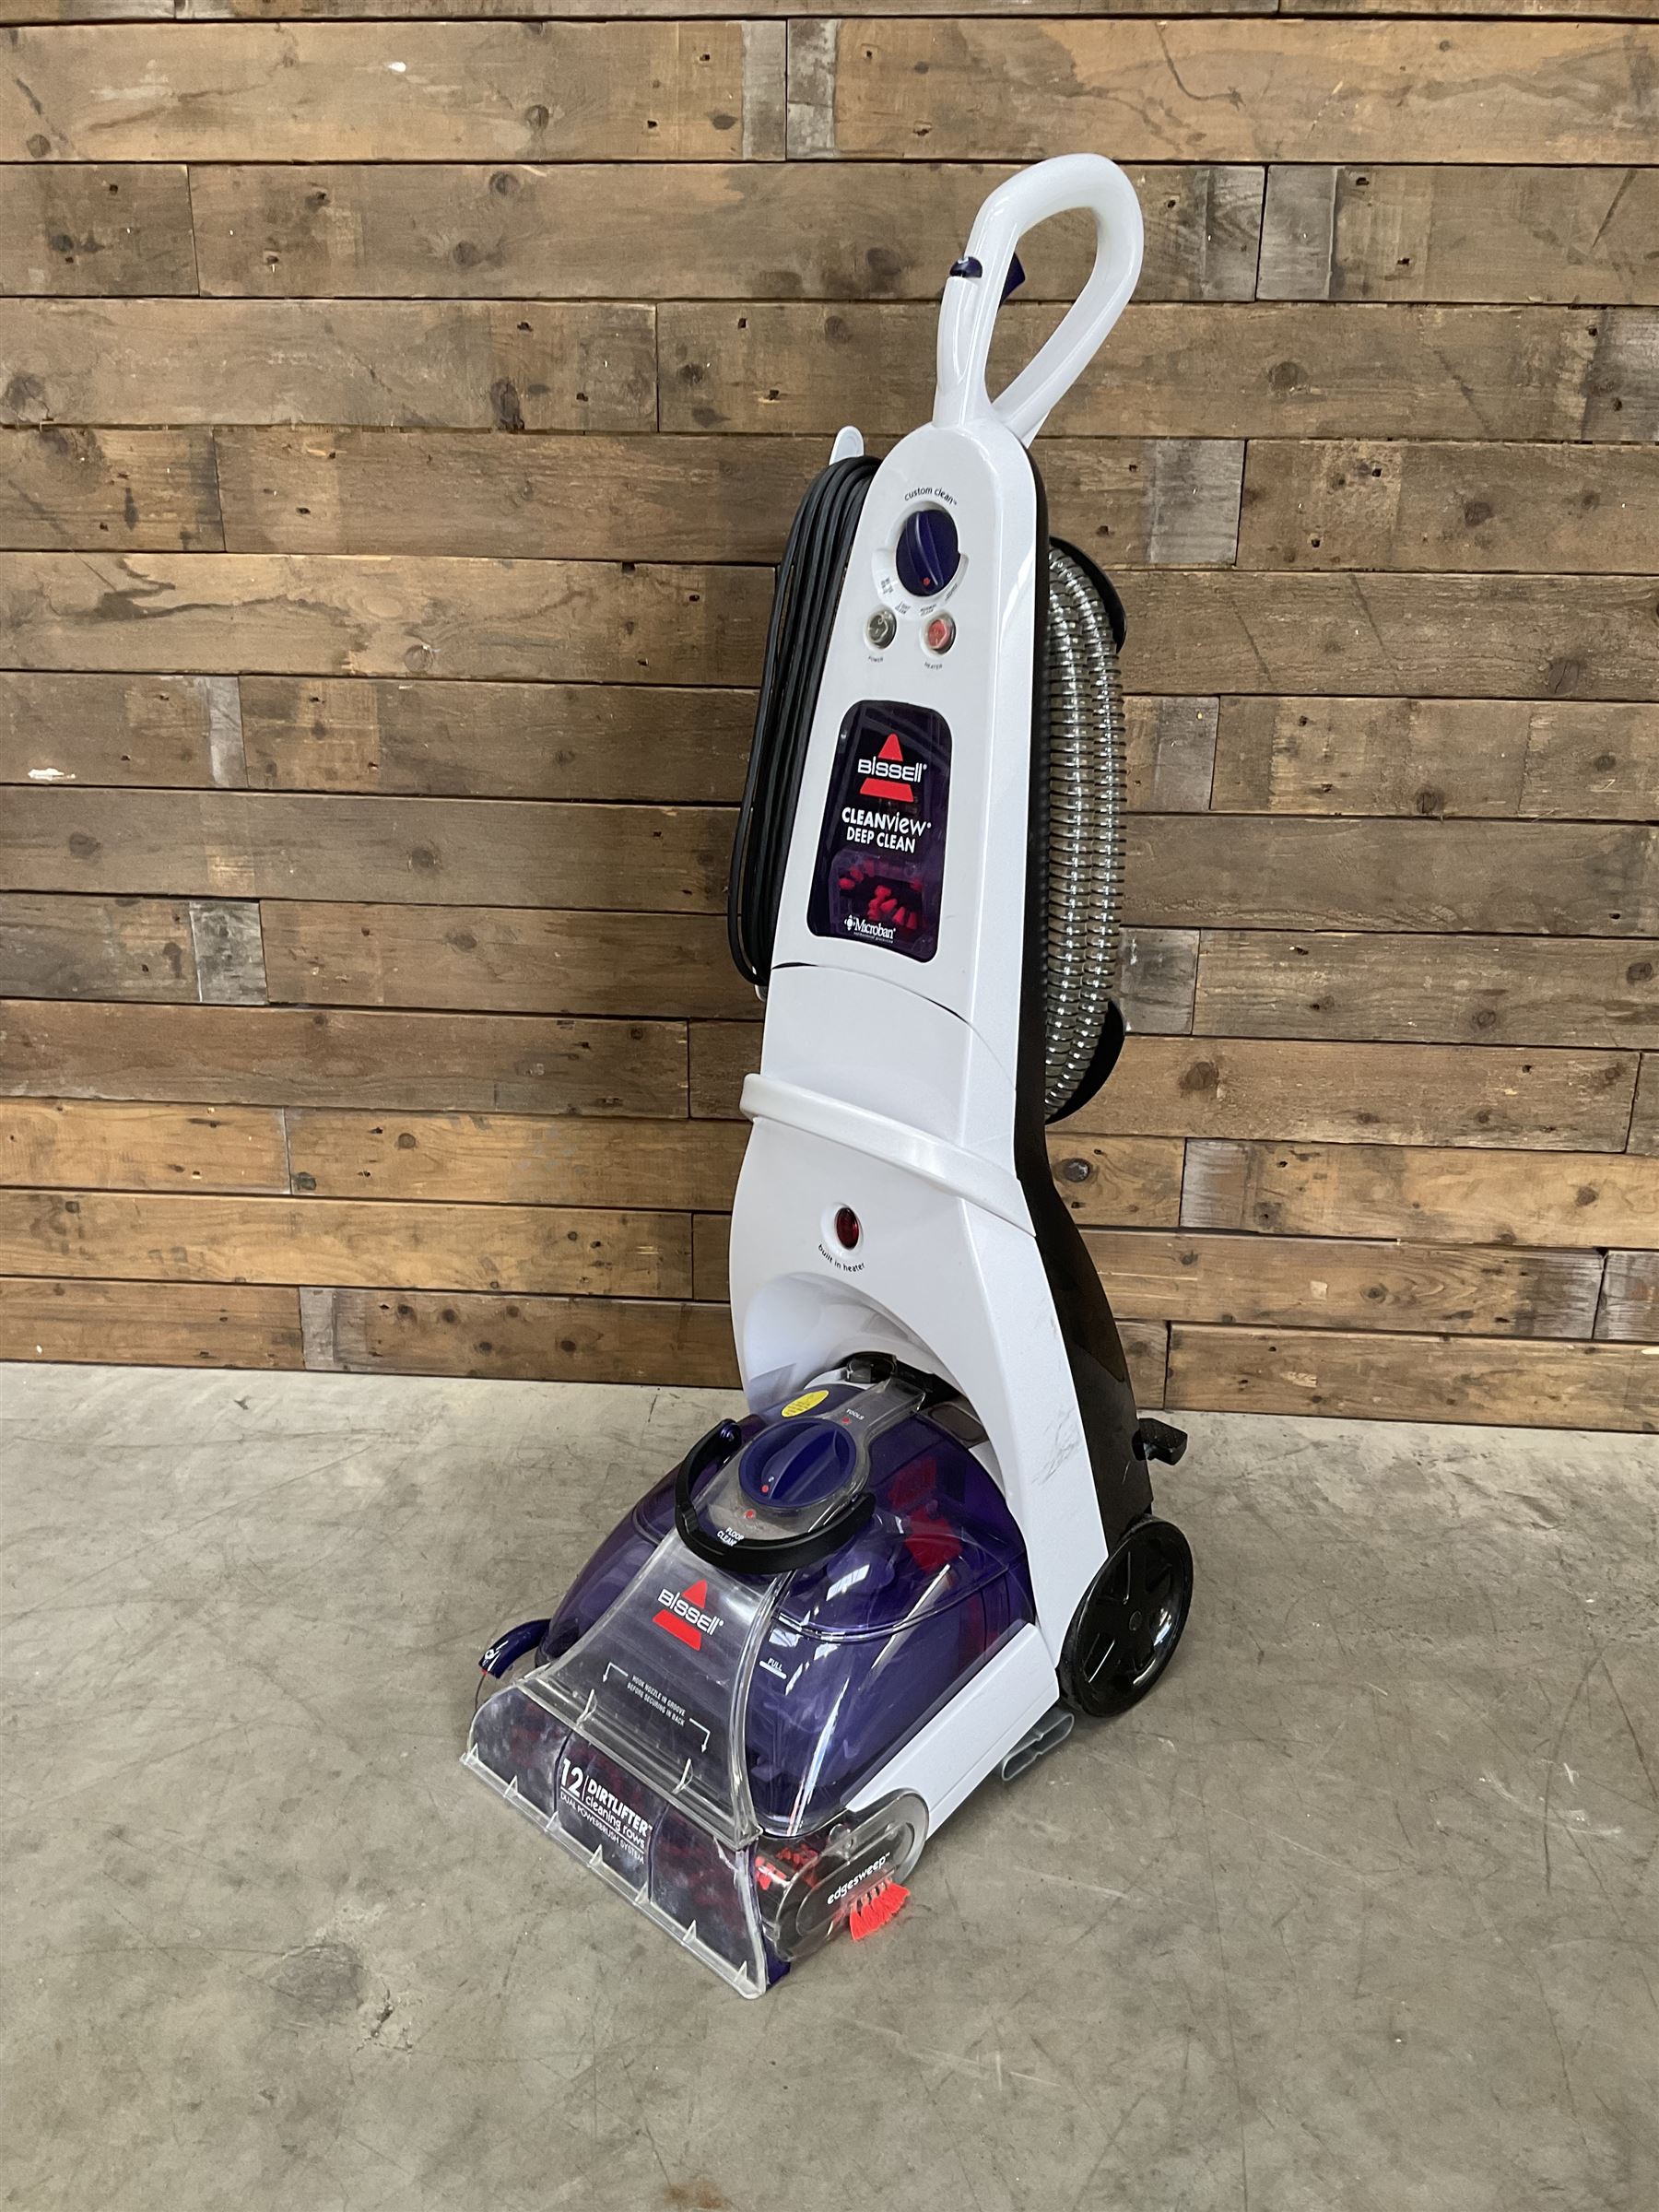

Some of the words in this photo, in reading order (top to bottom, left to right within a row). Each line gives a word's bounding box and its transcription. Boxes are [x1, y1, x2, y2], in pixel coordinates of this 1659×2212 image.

[905, 488, 933, 501] custom
[935, 488, 954, 504] clean
[841, 807, 926, 837] CLEANview
[846, 826, 875, 845] DEEP
[877, 831, 916, 853] CLEAN
[854, 918, 894, 939] Microban
[818, 1243, 833, 1264] built
[834, 1261, 841, 1269] in
[843, 1262, 865, 1272] heater
[846, 1408, 865, 1420] TOOLS
[768, 1658, 782, 1671] FULL
[627, 1681, 644, 1698] BEFORE
[644, 1693, 666, 1714] SECURING
[665, 1709, 672, 1718] IN
[672, 1713, 685, 1726] BACK
[632, 1675, 645, 1688] HOOK
[644, 1683, 662, 1700] NOZZLE
[661, 1696, 667, 1704] IN
[666, 1700, 686, 1717] GROOVE
[560, 1758, 583, 1797] 12
[585, 1795, 621, 1832] cleaning
[622, 1824, 645, 1850] rows
[587, 1778, 647, 1837] DIRTLIFTER
[560, 1791, 576, 1811] DUAL
[577, 1805, 619, 1844] POWERBRUSH
[620, 1840, 644, 1865] SYSTEM
[827, 1855, 886, 1904] edgesweep
